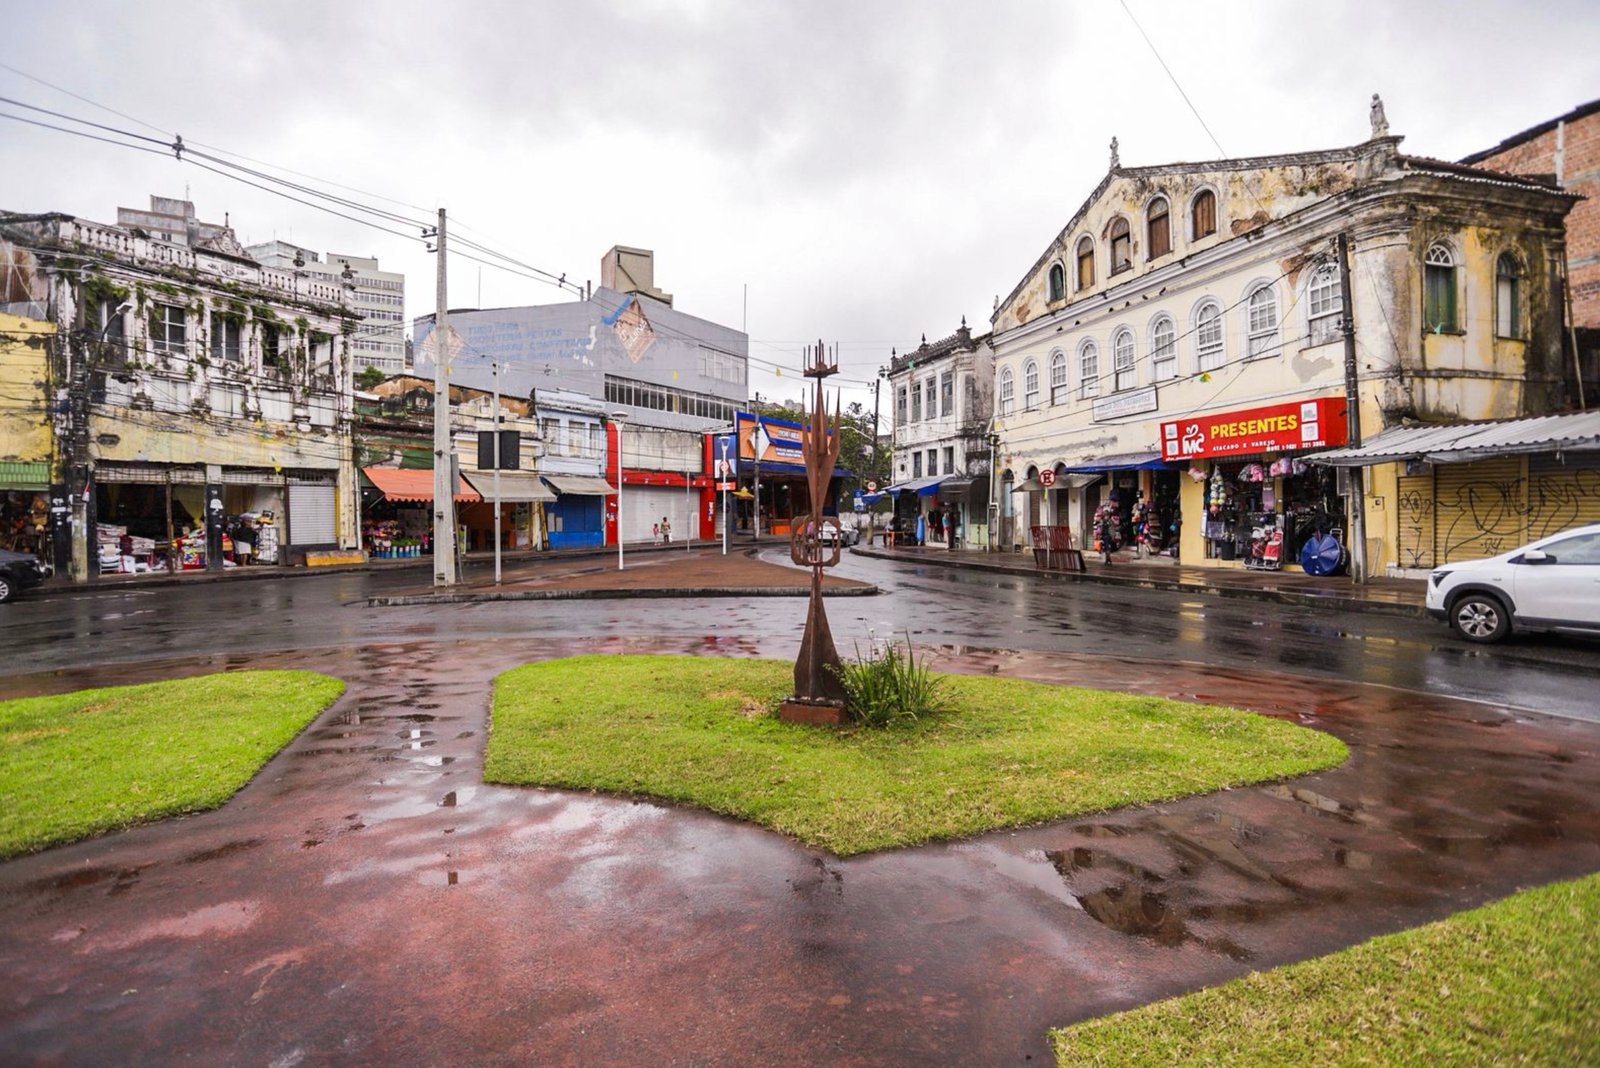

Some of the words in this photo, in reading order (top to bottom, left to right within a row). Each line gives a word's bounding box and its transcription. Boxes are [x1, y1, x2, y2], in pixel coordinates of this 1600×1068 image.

[1211, 415, 1297, 439] PRESENTES
[1183, 436, 1205, 454] MC
[1212, 443, 1239, 451] ATACADO
[1251, 440, 1276, 448] VAREJO
